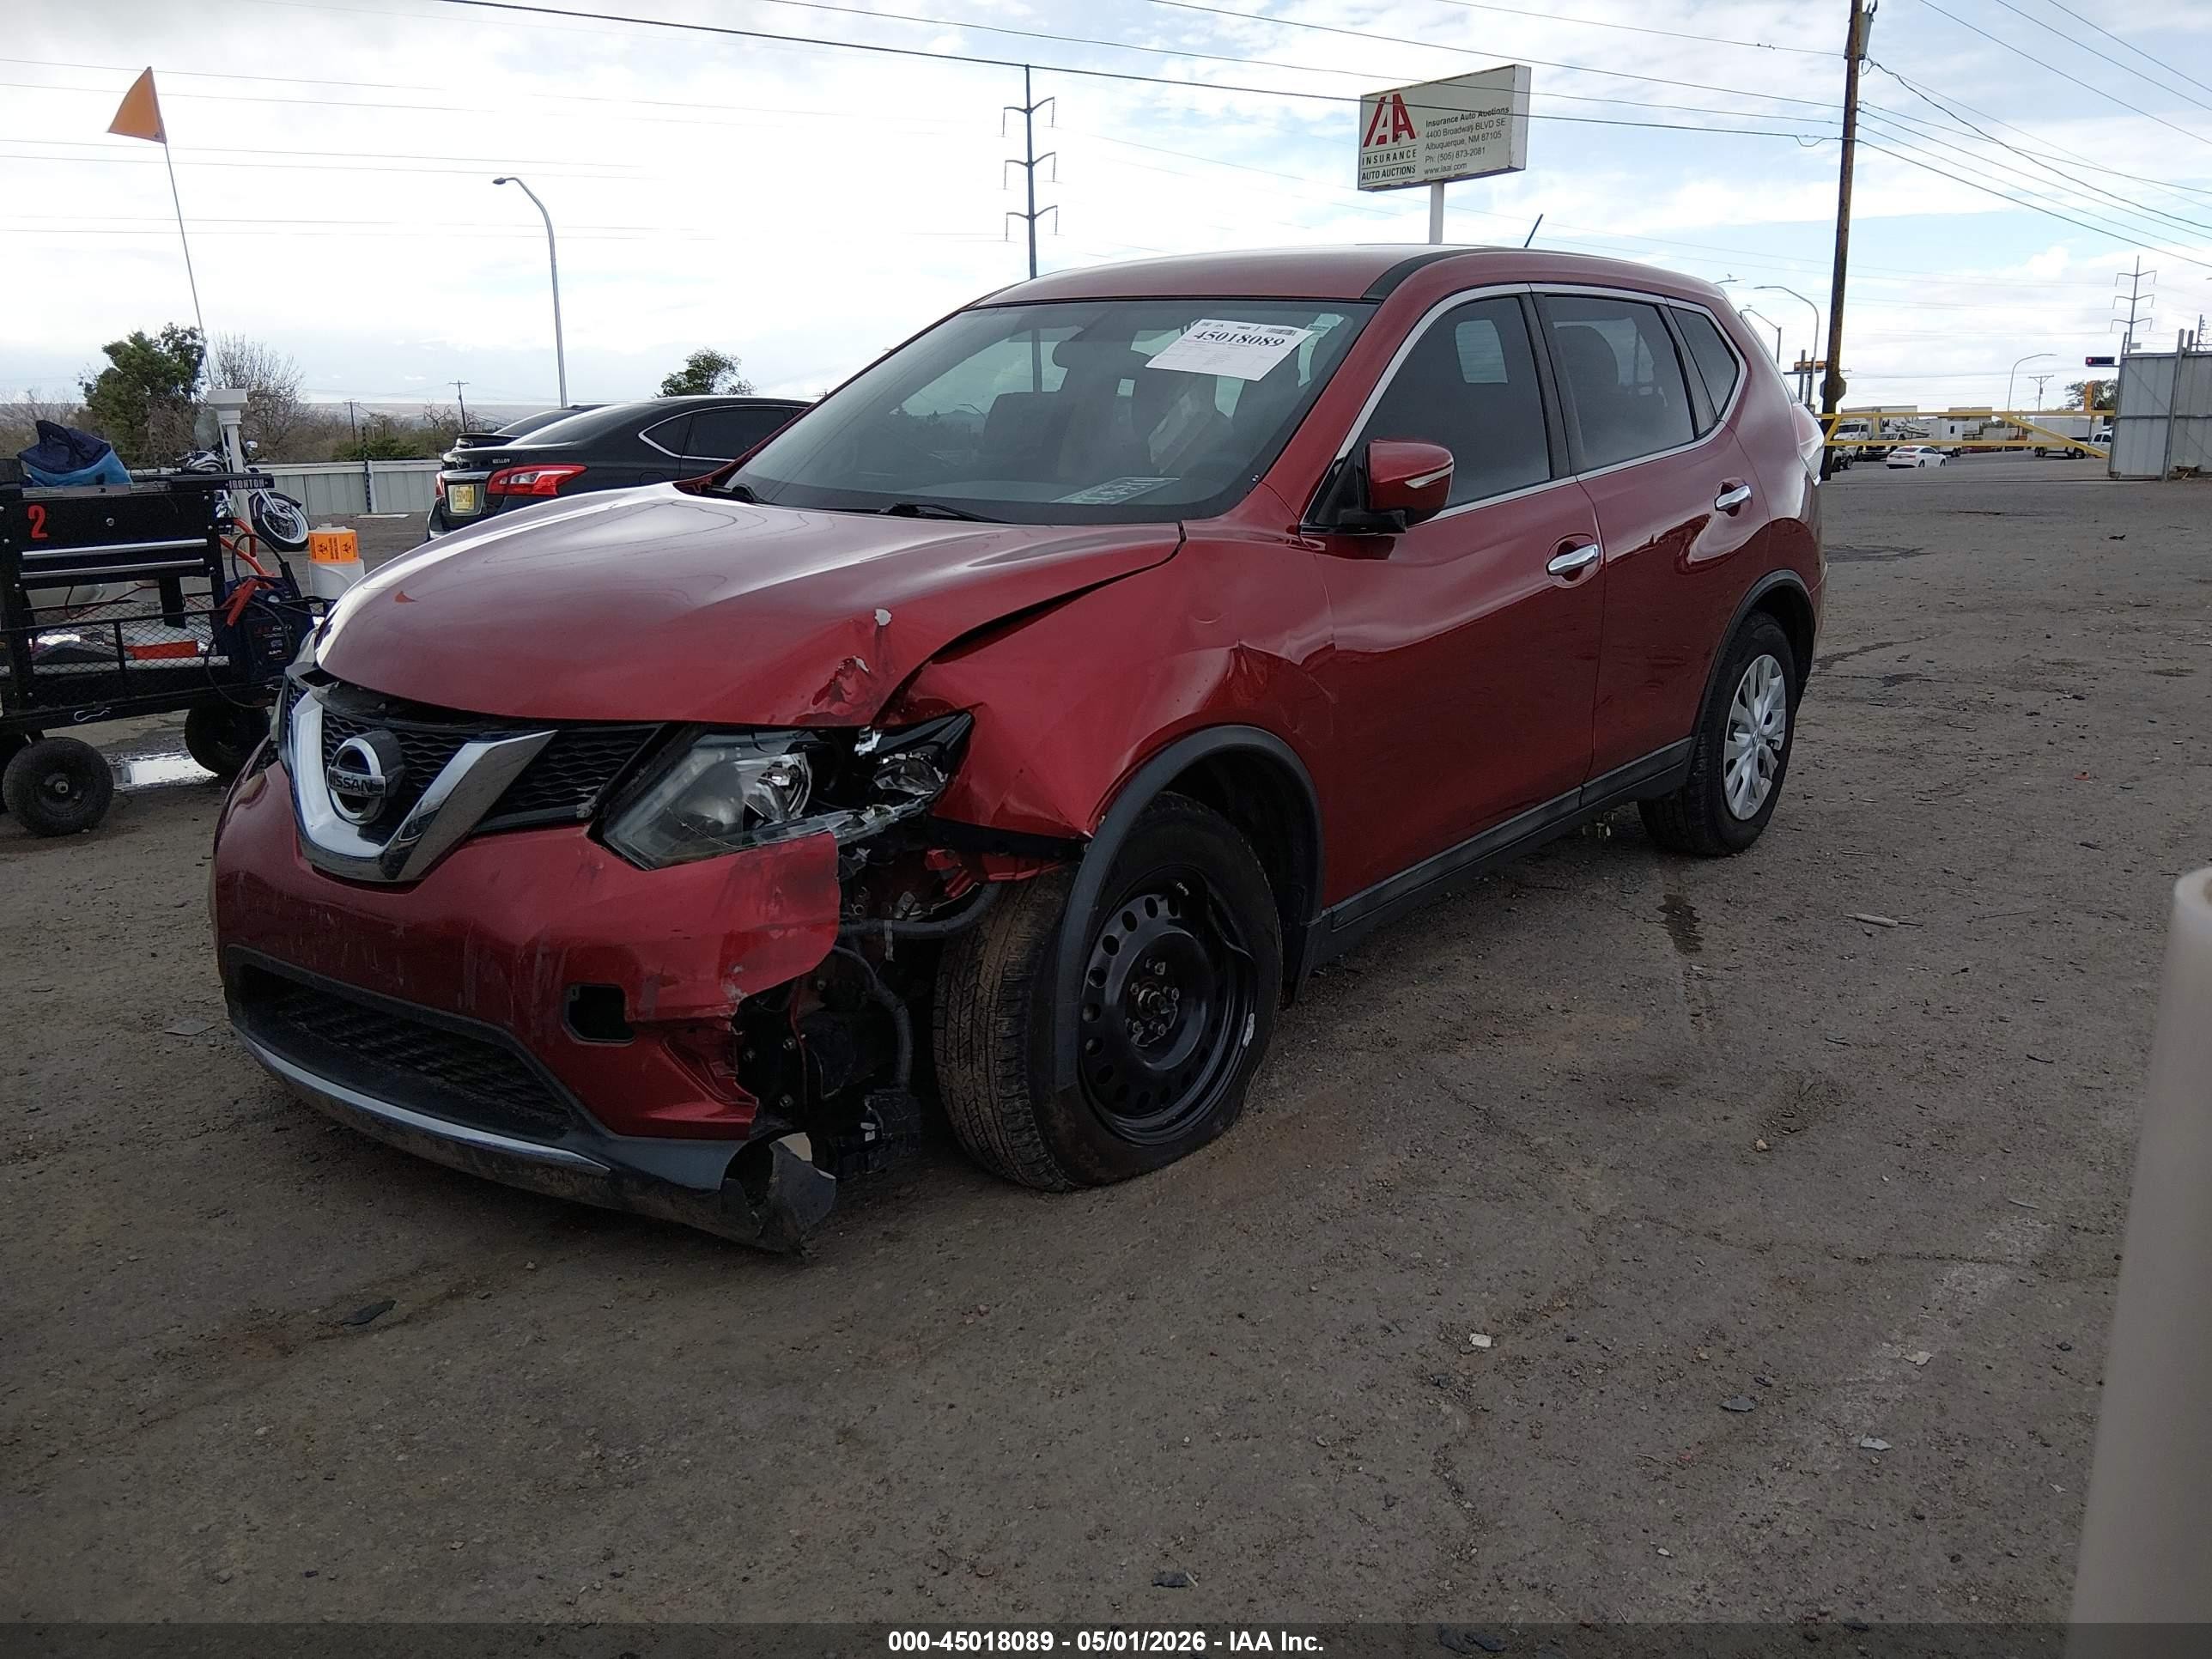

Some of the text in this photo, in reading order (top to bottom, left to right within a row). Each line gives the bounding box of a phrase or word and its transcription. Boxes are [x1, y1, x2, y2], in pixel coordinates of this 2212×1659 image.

[1425, 106, 1510, 128] Insurance Auto Auctions
[1425, 117, 1506, 139] 4400 Broadway BLVD SE
[1468, 134, 1480, 144] NM
[1480, 130, 1502, 142] 87105
[1362, 149, 1417, 166] INSURANCE
[1361, 164, 1416, 181] AUTO AUCTIONS
[1194, 331, 1285, 347] 45018089
[228, 477, 265, 489] IRONTON
[27, 505, 48, 539] 2
[330, 774, 374, 793] NISSAN
